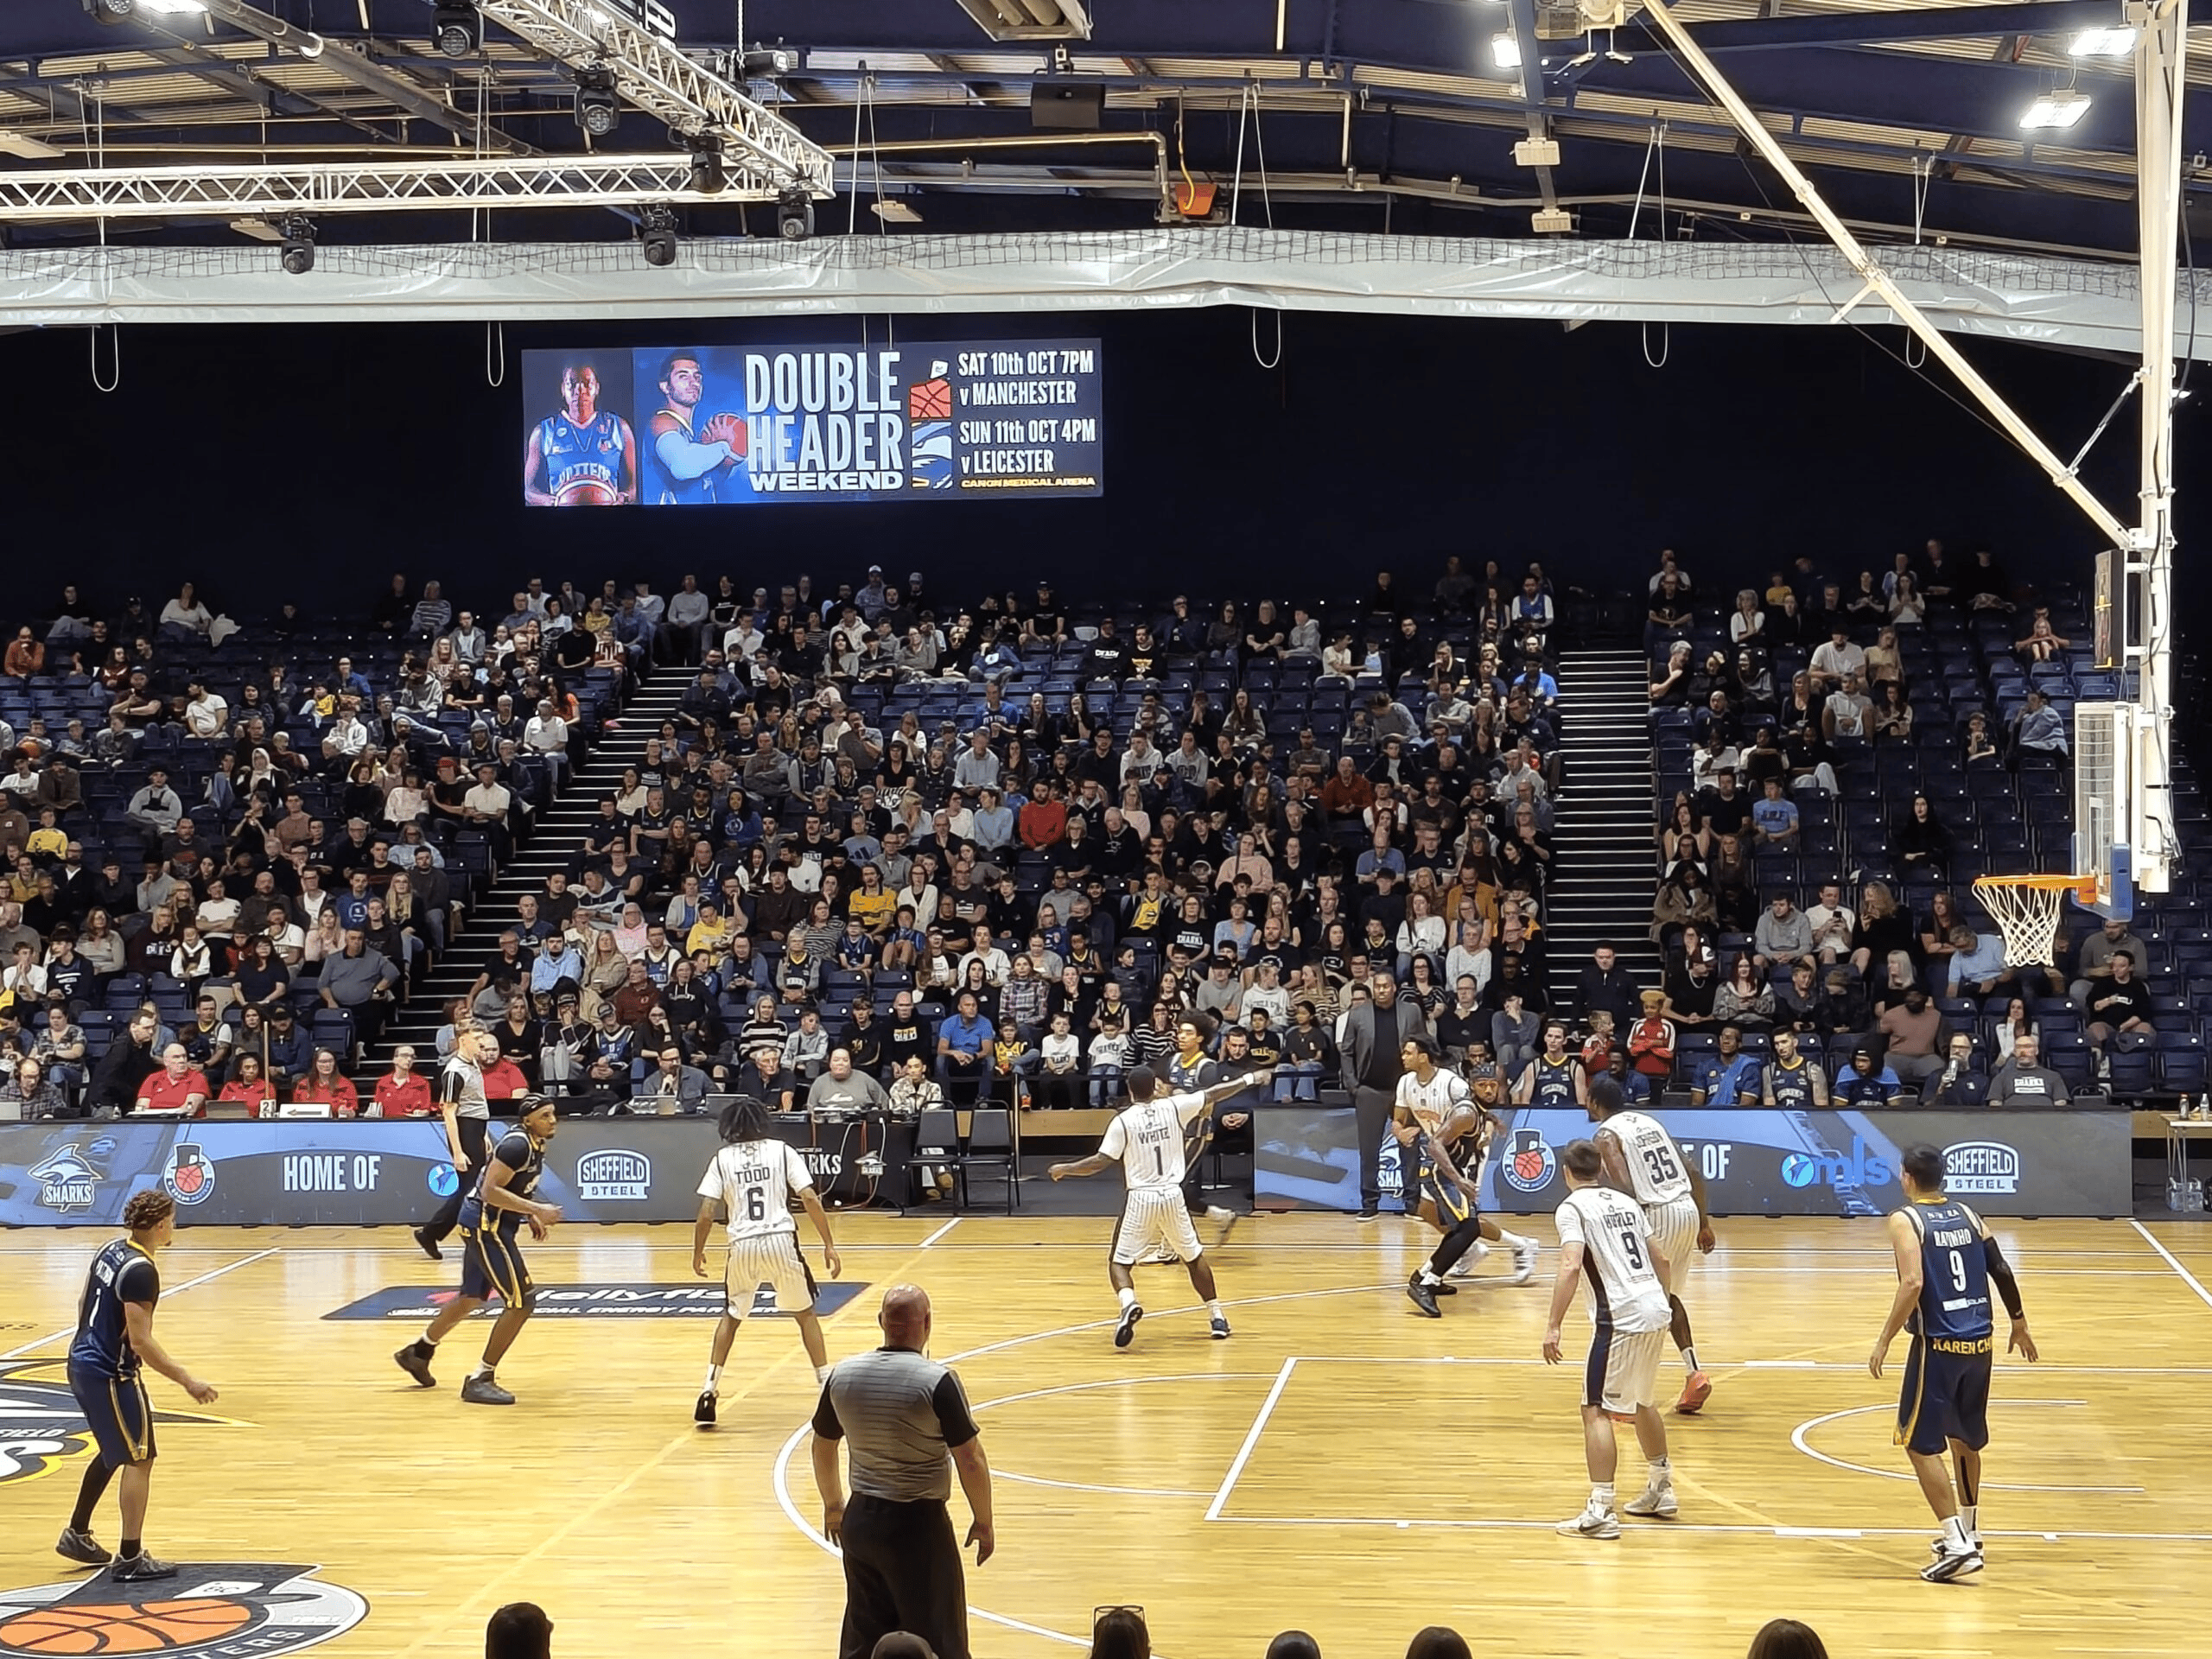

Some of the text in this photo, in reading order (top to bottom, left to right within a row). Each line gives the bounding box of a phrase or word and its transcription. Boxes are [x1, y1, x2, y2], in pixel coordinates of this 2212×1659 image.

[958, 350, 1094, 376] SAT 10th OCT 7PM
[746, 352, 901, 413] DOUBLE
[972, 380, 1077, 406] MANCHESTER
[747, 413, 904, 472] HEADER
[959, 419, 1096, 444] SUN 11th OCT 4PM
[974, 449, 1054, 474] LEICESTER
[749, 471, 904, 491] WEEKEND
[1055, 477, 1096, 486] ARENA
[283, 1154, 381, 1192] HOME OF
[582, 1155, 645, 1182] SHEFFIELD
[1154, 1146, 1163, 1176] 1
[1643, 1146, 1678, 1185] 35
[1702, 1143, 1732, 1180] OF
[1812, 1134, 1891, 1185] mls
[1946, 1147, 2013, 1174] SHEFFIELD
[591, 1185, 638, 1196] STEEL
[1377, 1169, 1403, 1189] SHA
[1955, 1179, 2005, 1190] STEEL
[46, 1185, 92, 1204] SHARKS
[747, 1186, 765, 1221] 6
[1621, 1230, 1643, 1269] 9
[1948, 1249, 1967, 1293] 9
[1933, 1338, 1976, 1355] KAREN
